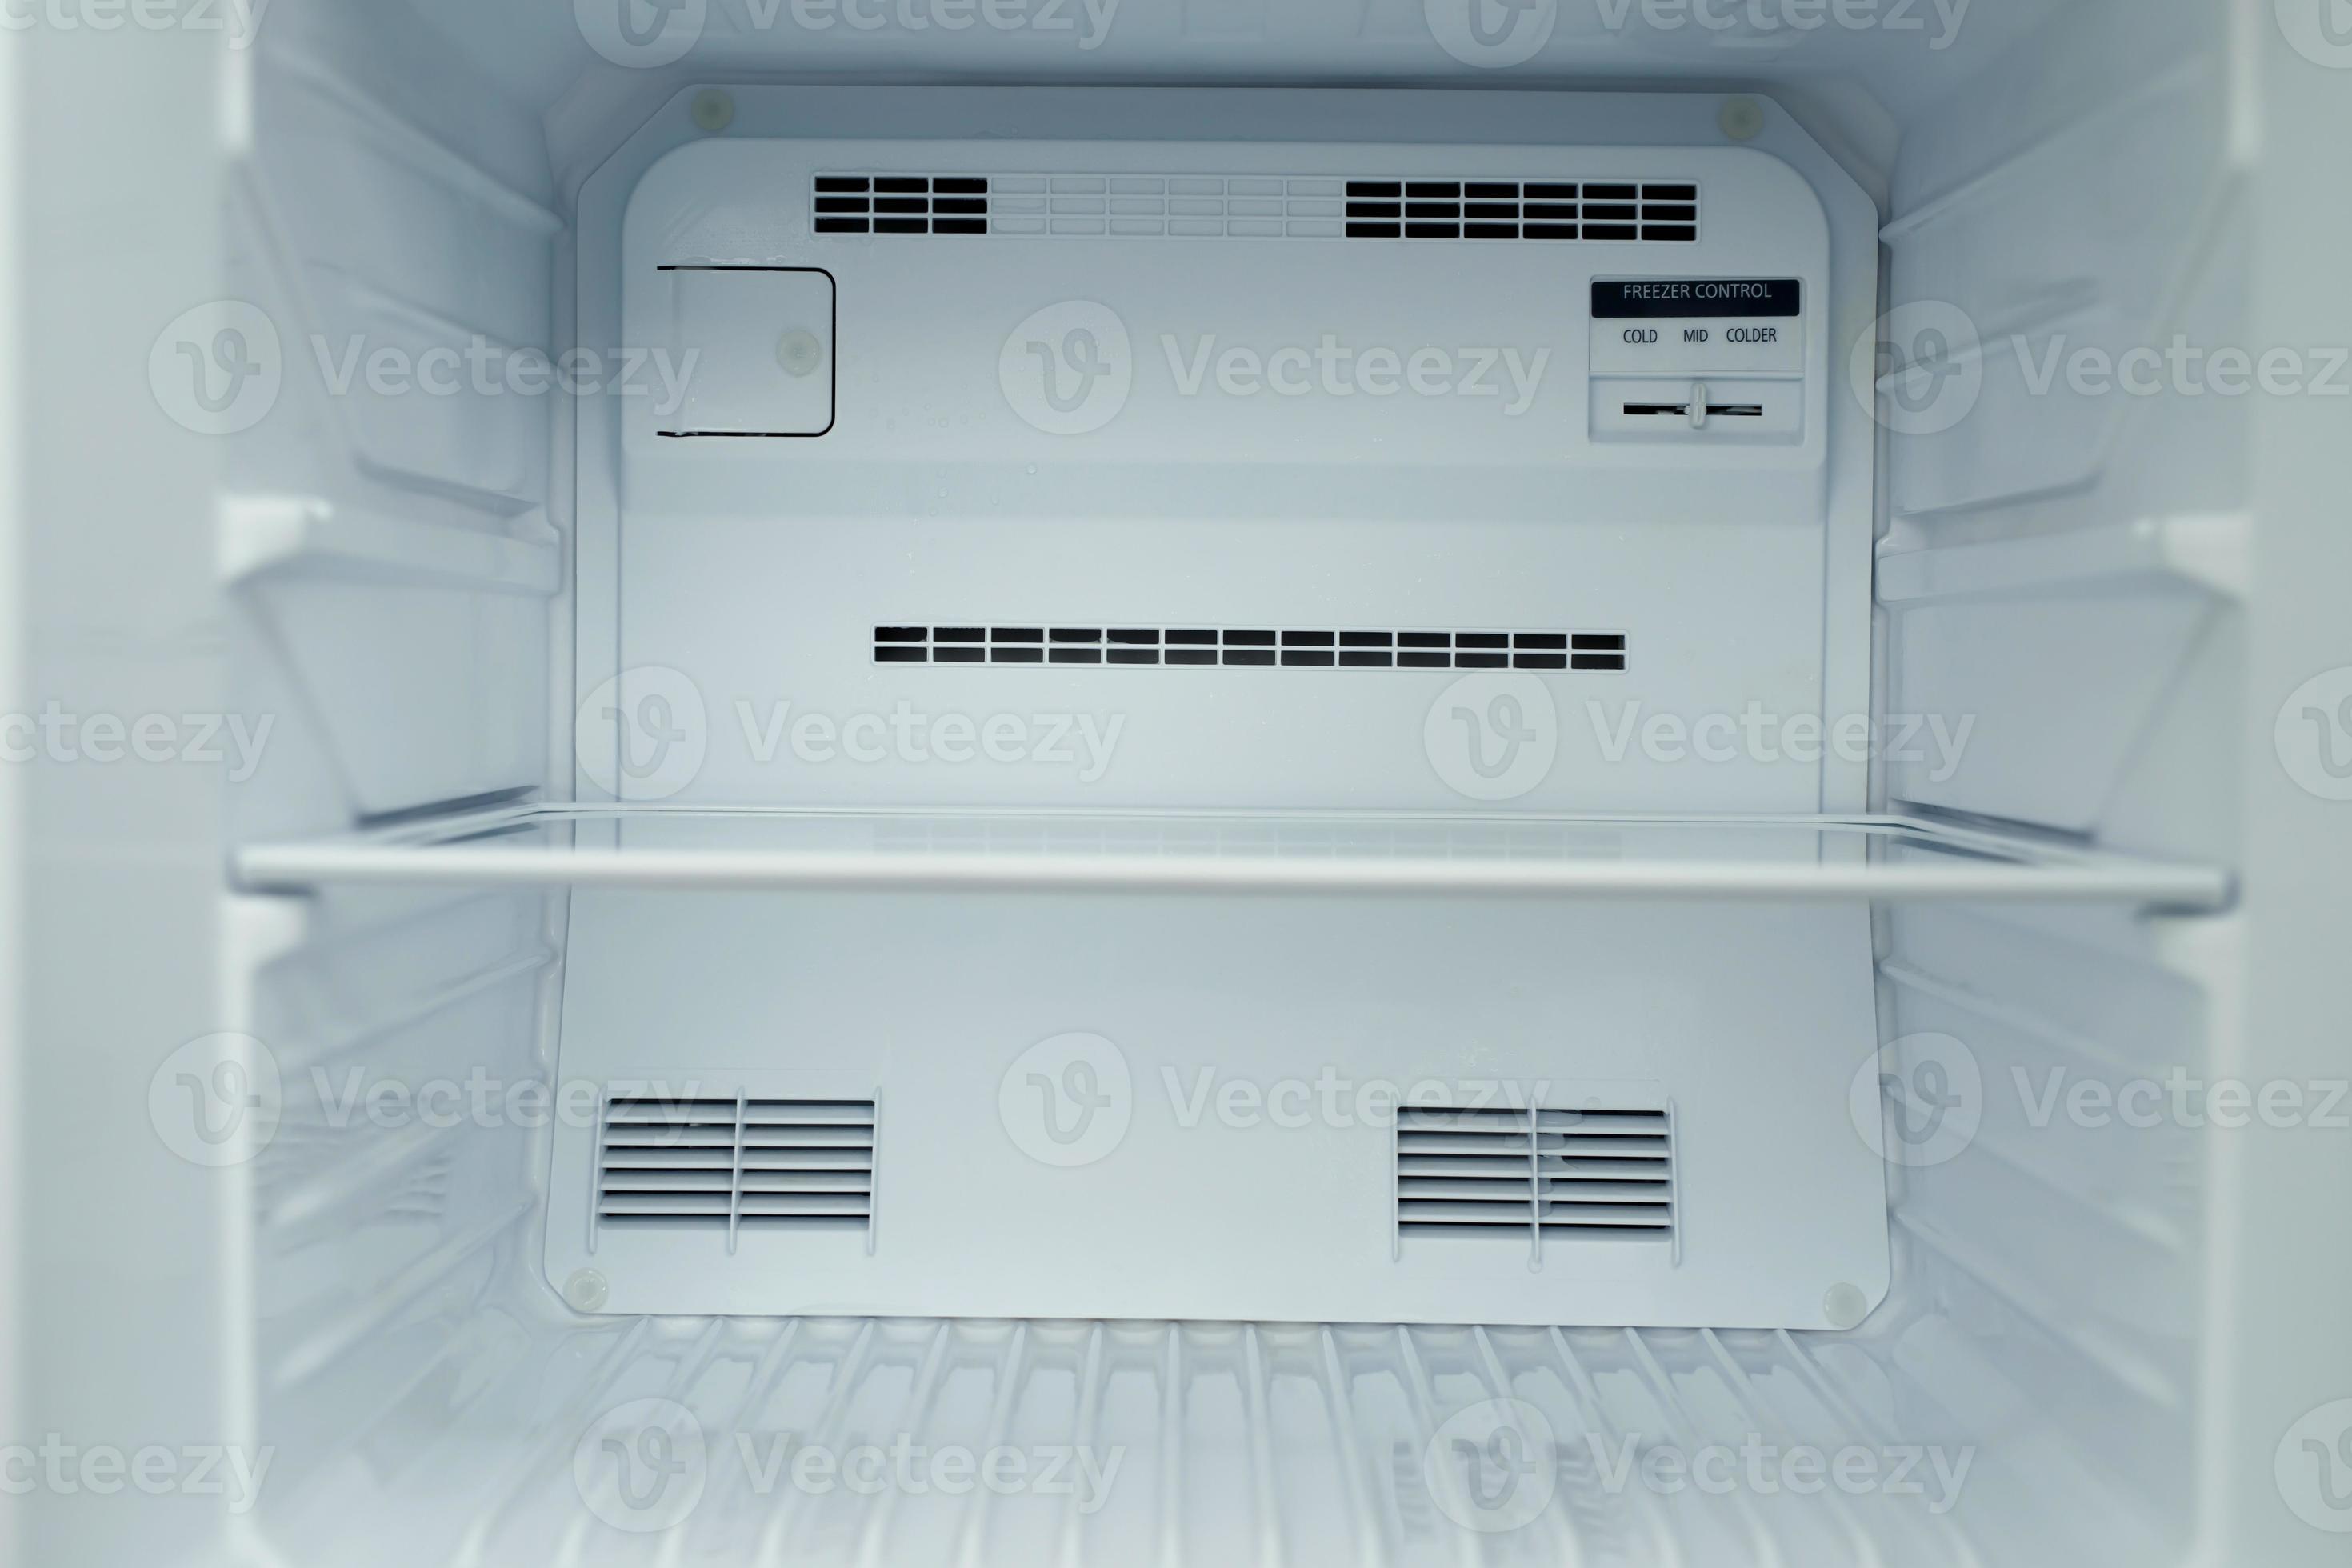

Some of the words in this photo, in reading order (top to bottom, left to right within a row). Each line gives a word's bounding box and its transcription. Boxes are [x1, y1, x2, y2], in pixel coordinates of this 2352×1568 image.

[1624, 284, 1690, 299] FREEZER
[1695, 283, 1772, 298] CONTROL
[1623, 329, 1658, 344] COLD
[1683, 329, 1709, 342] MID
[1726, 327, 1777, 342] COLDER
